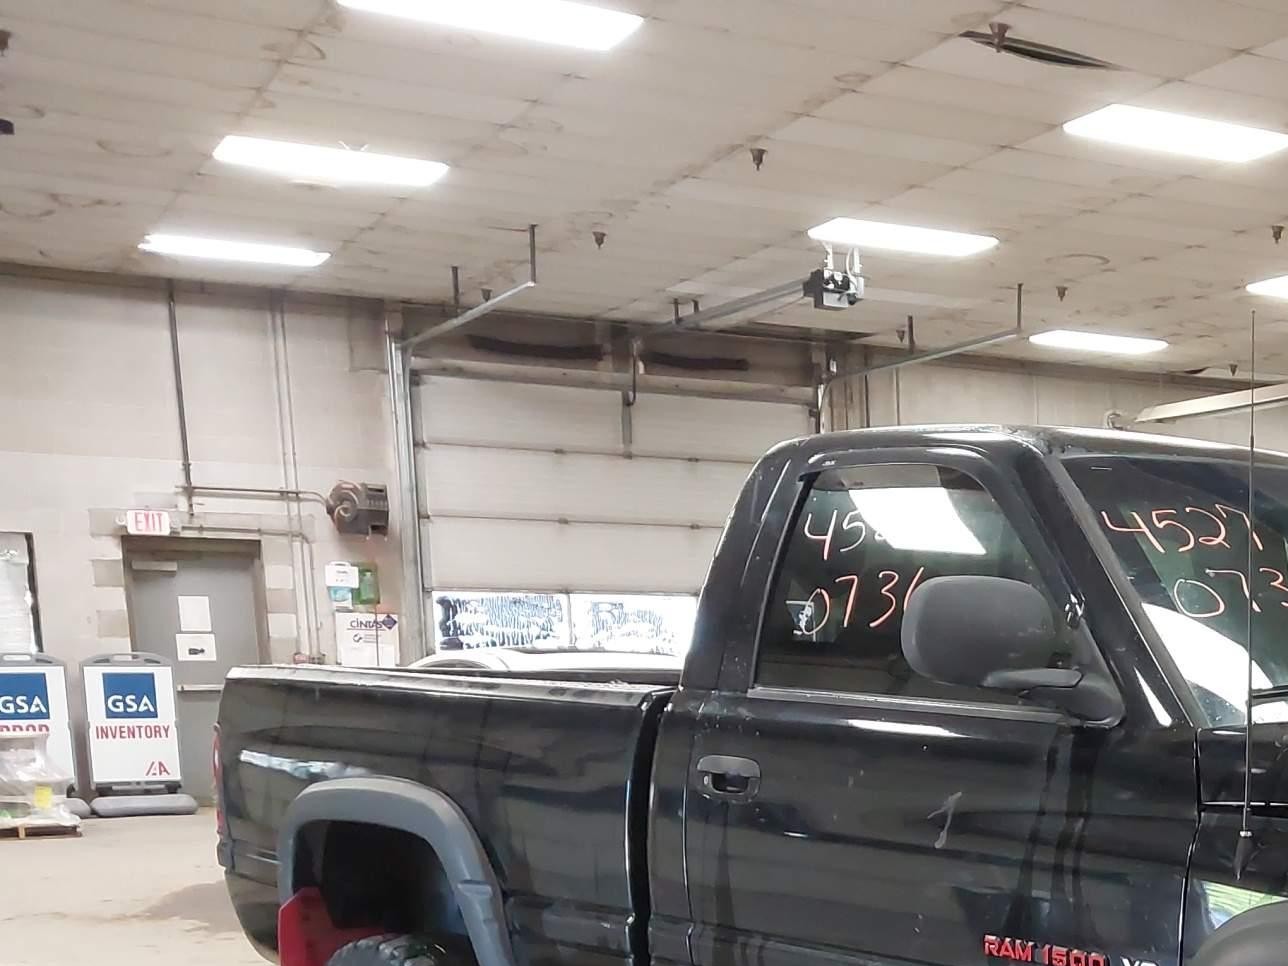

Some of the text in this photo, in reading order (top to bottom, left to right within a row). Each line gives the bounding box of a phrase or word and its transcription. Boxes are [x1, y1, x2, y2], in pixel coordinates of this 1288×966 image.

[134, 512, 164, 532] EXIT
[1100, 503, 1263, 554] 4527
[0, 695, 47, 714] GSA
[107, 694, 155, 713] GSA
[95, 724, 170, 740] INVENTORY
[983, 934, 1035, 962] RAM
